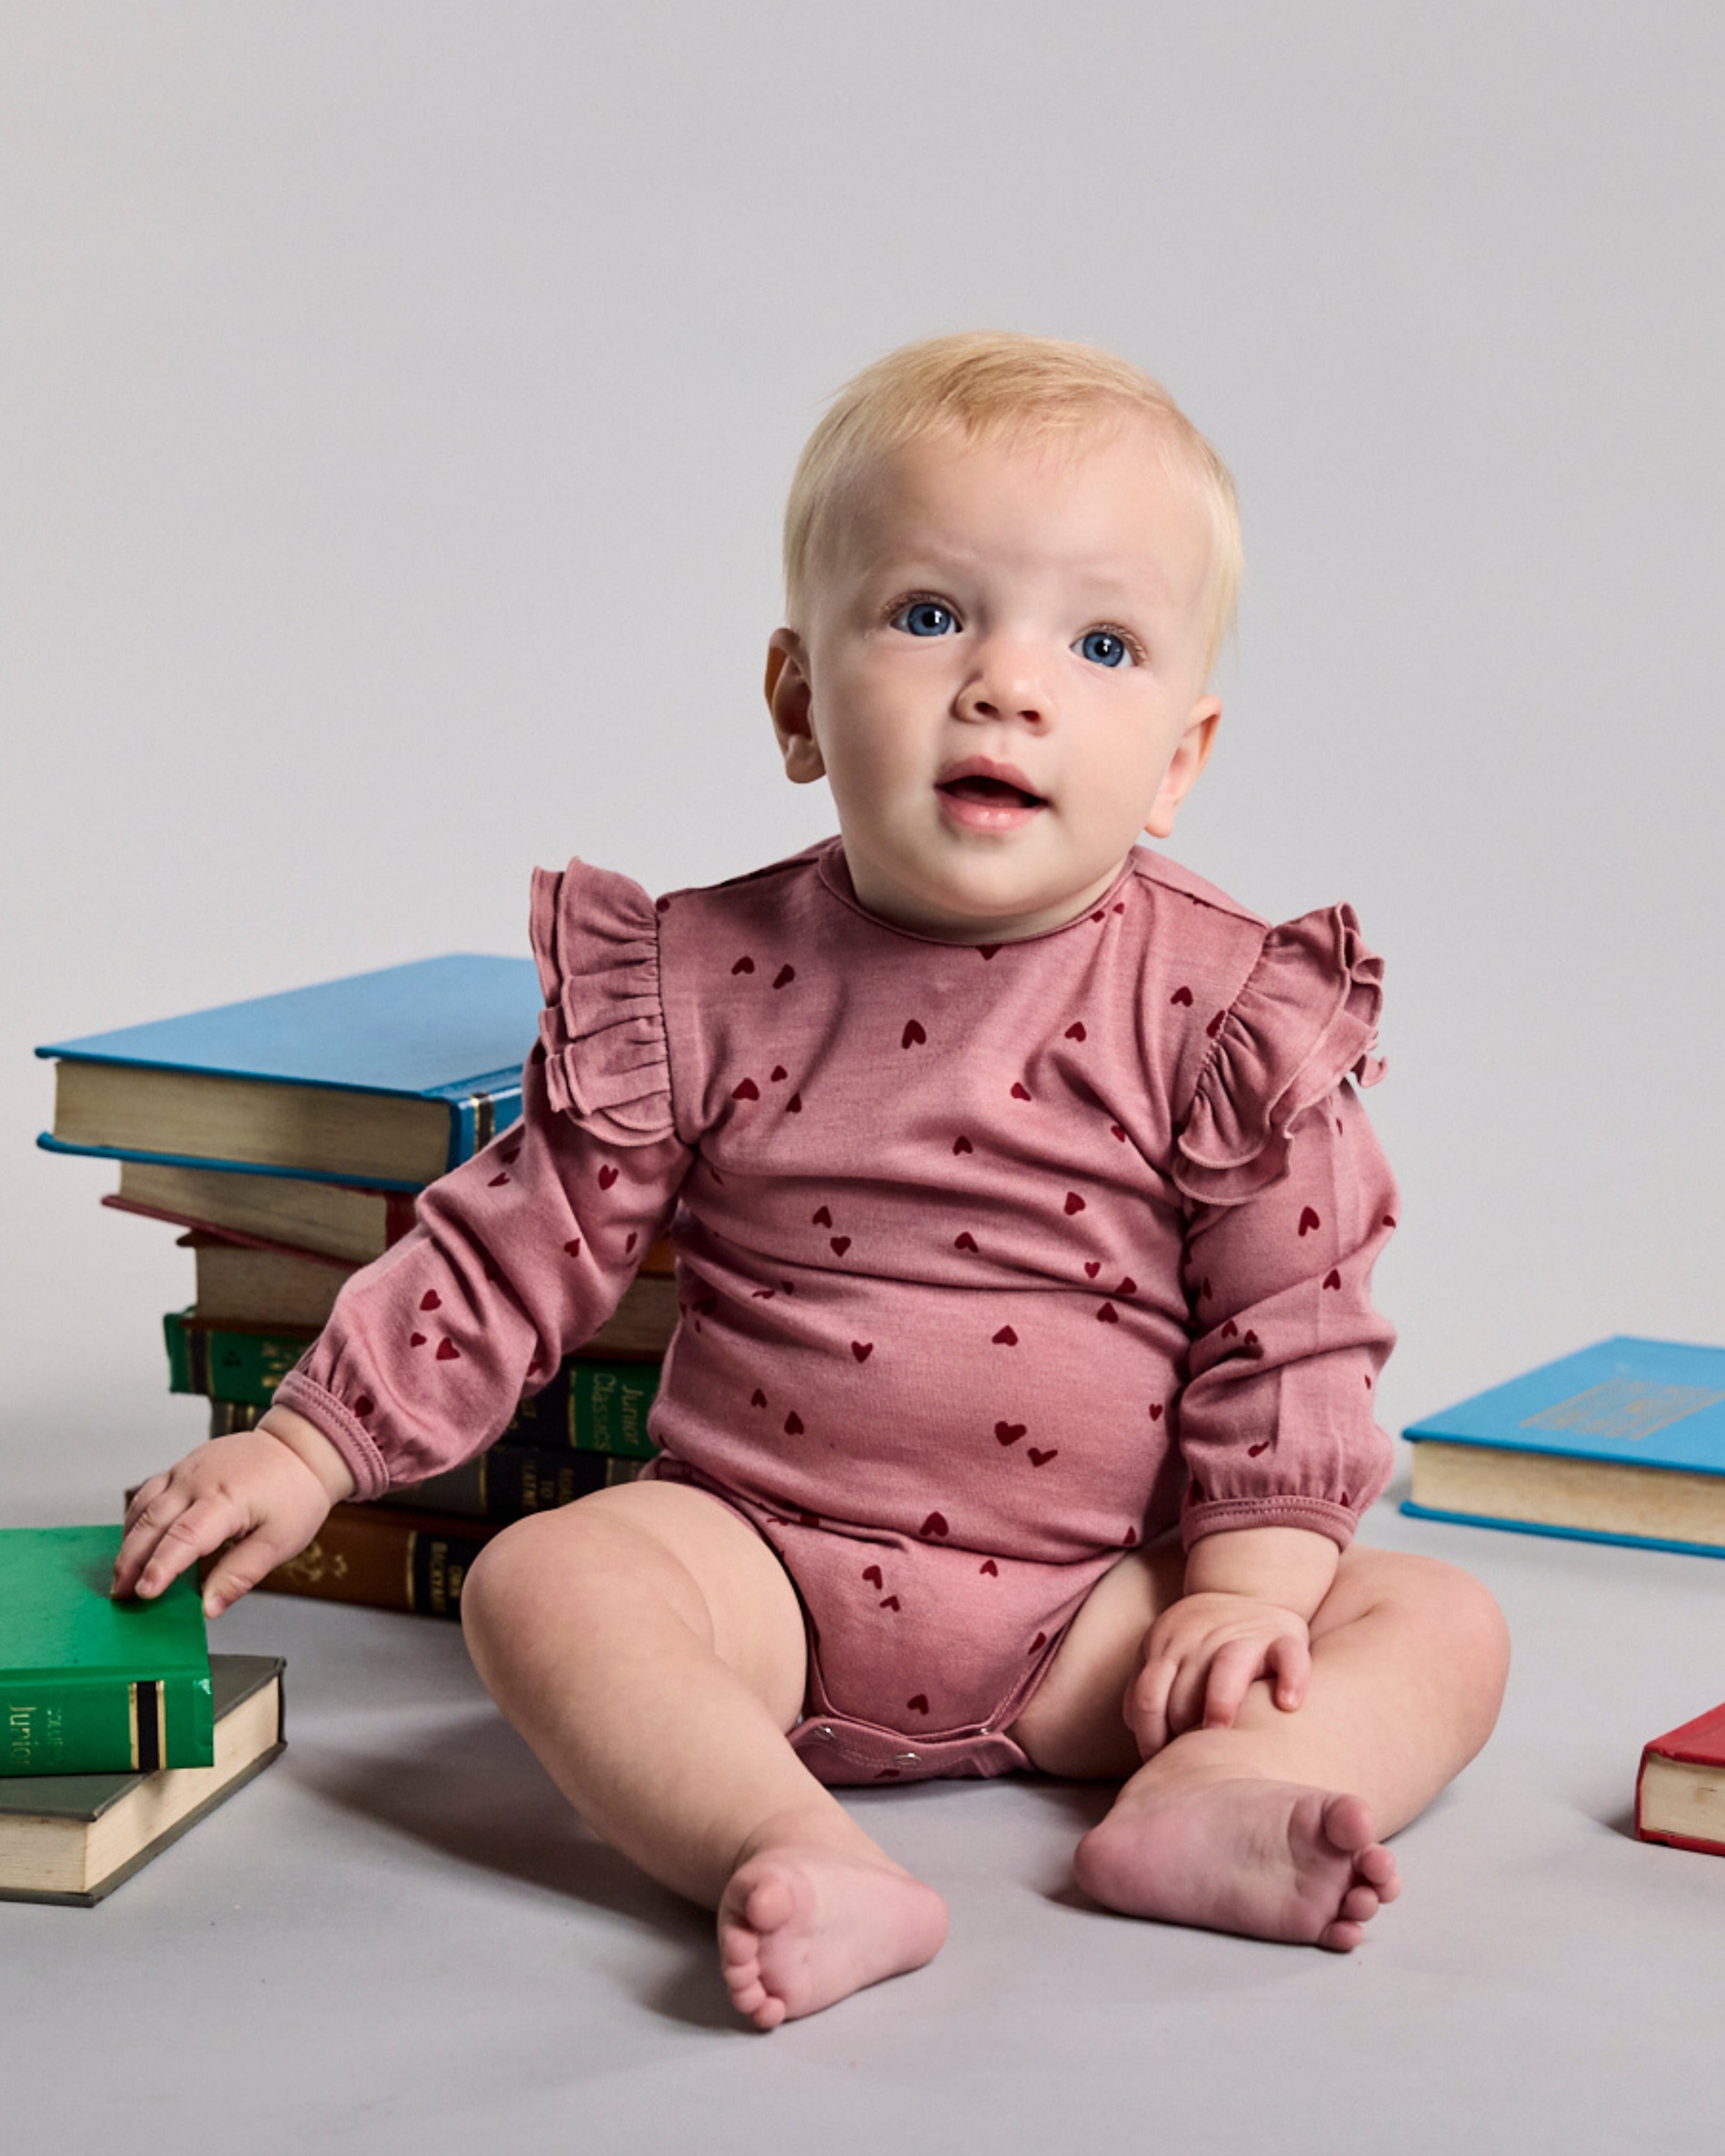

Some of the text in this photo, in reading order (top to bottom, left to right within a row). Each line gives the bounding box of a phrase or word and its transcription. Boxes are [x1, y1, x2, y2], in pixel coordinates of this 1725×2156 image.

[591, 1373, 617, 1451] Classics
[622, 1384, 644, 1445] Junior
[10, 1705, 38, 1765] Junior
